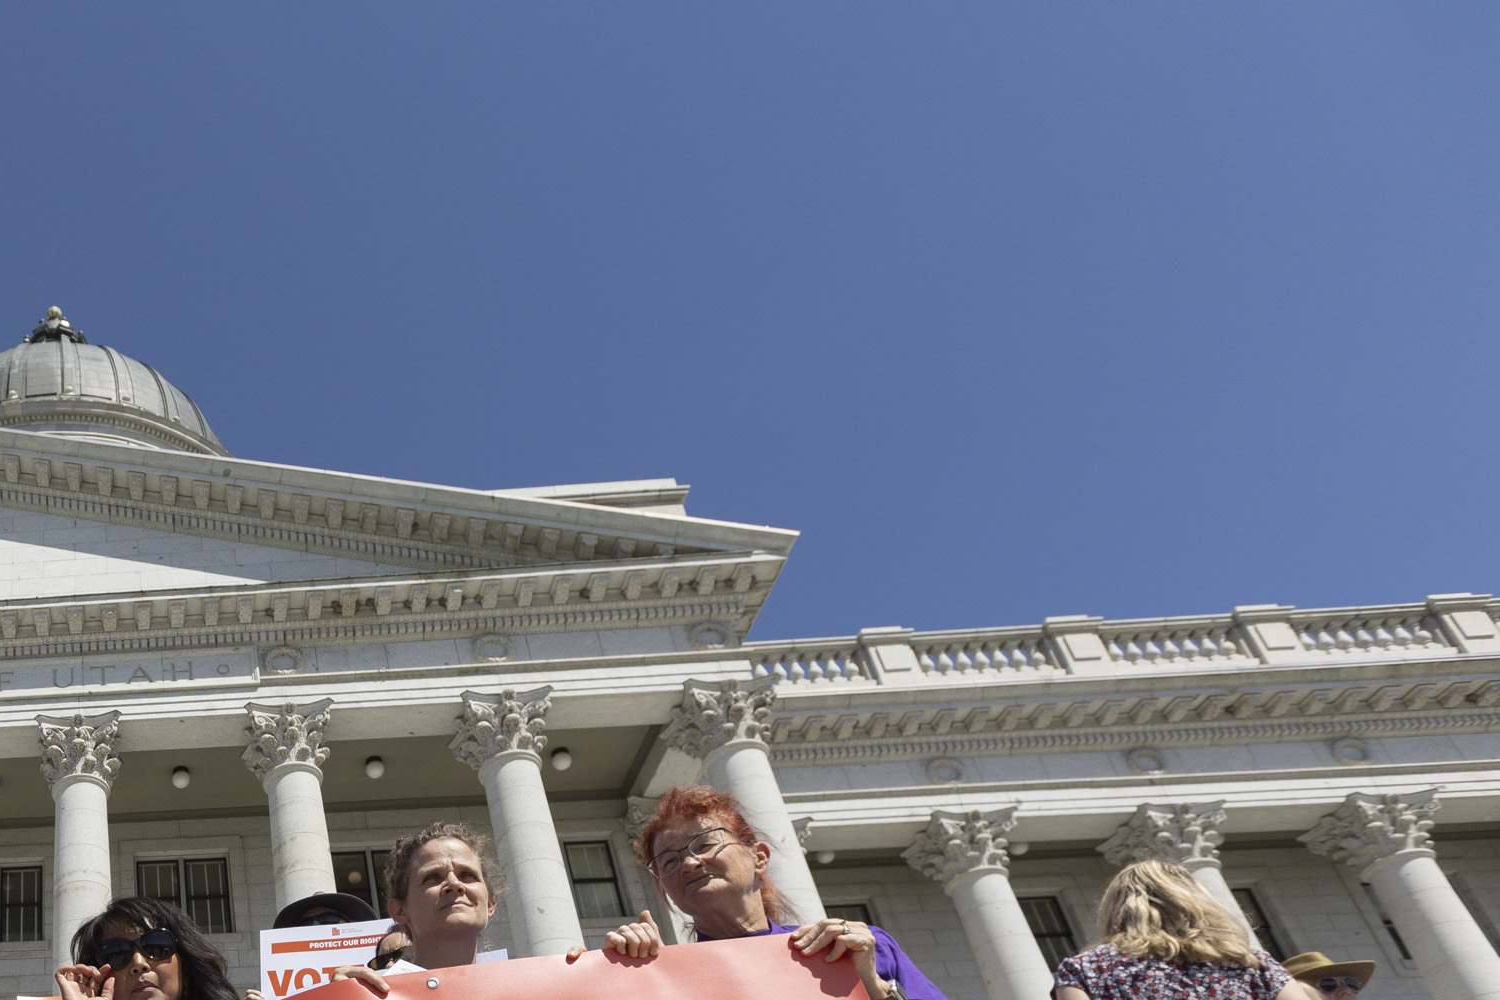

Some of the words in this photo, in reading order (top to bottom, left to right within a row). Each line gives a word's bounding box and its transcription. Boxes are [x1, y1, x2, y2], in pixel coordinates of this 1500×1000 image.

[51, 659, 195, 688] UTAH
[309, 940, 342, 949] PROTECT
[343, 938, 359, 947] OUR
[360, 936, 383, 945] RIGHT
